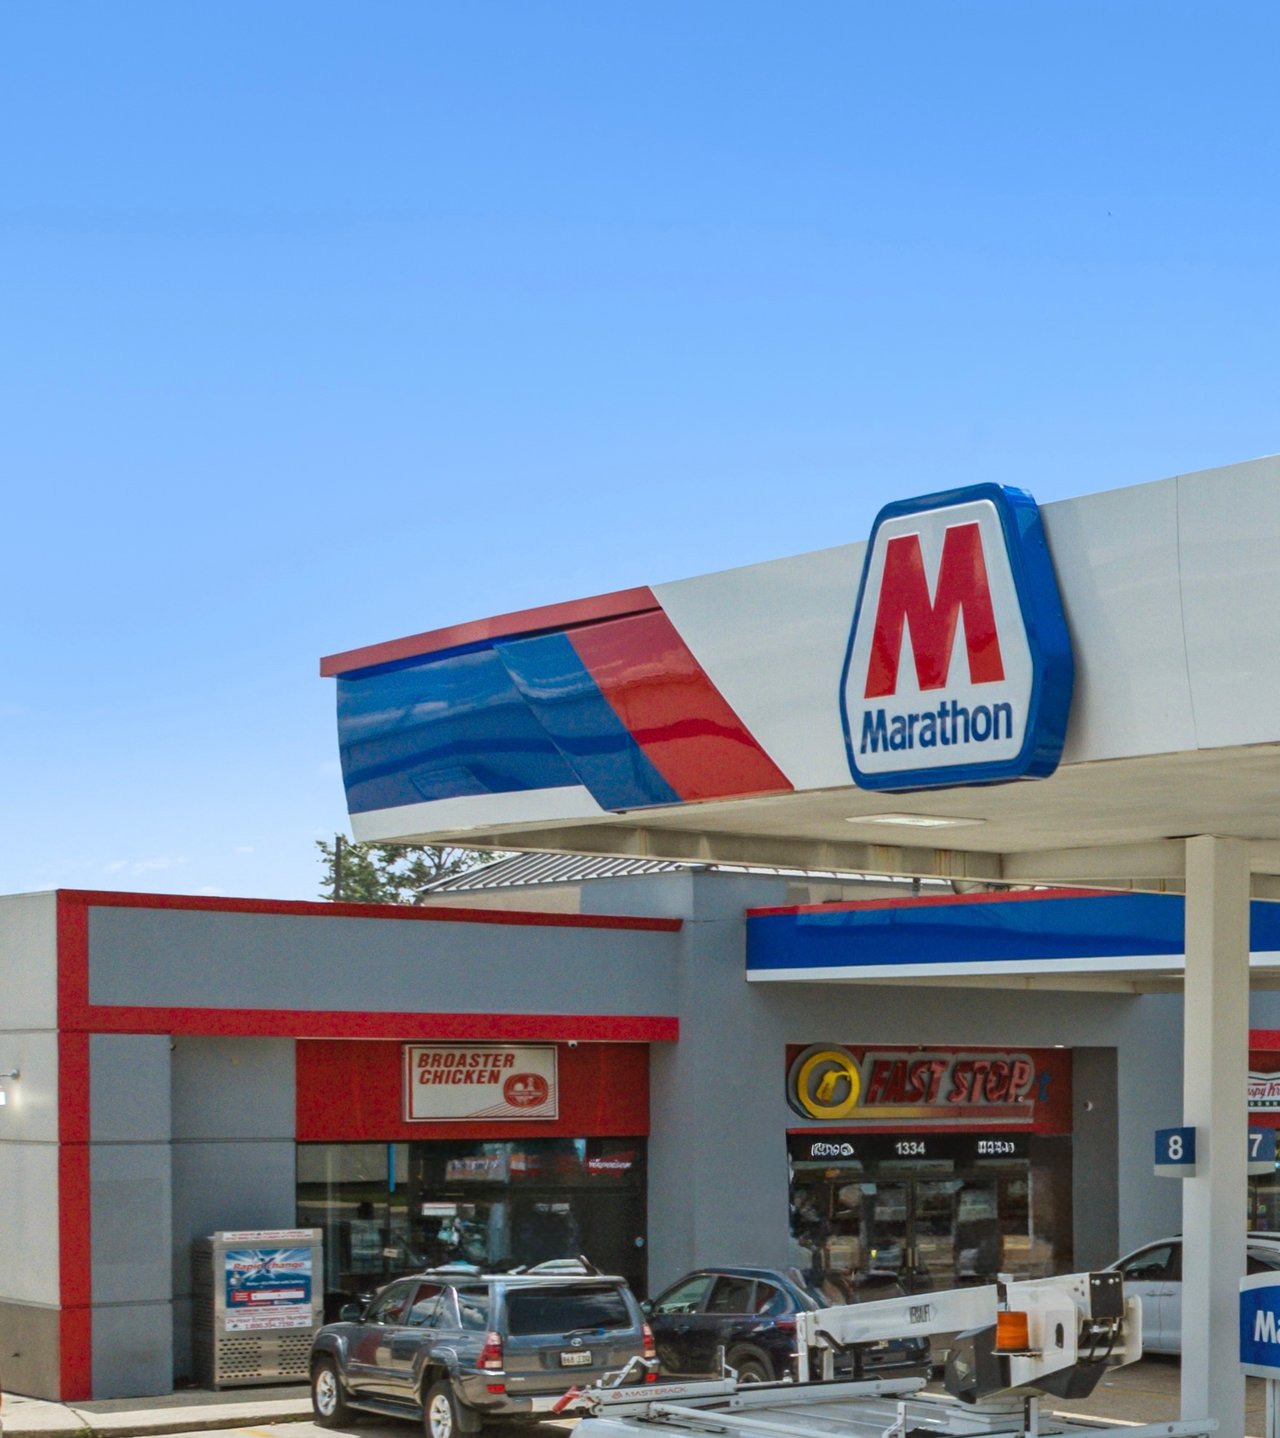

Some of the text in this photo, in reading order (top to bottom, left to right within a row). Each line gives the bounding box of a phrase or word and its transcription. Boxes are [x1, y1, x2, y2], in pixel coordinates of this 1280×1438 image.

[864, 522, 1005, 699] M
[860, 700, 1013, 754] Marathon
[418, 1053, 515, 1069] BROASTER
[419, 1069, 502, 1085] CHICKEN
[866, 1059, 1031, 1105] FAST STOP
[896, 1142, 926, 1155] 1334
[1168, 1135, 1184, 1160] 8
[1249, 1134, 1263, 1157] 7
[625, 1386, 688, 1399] MASTERACK
